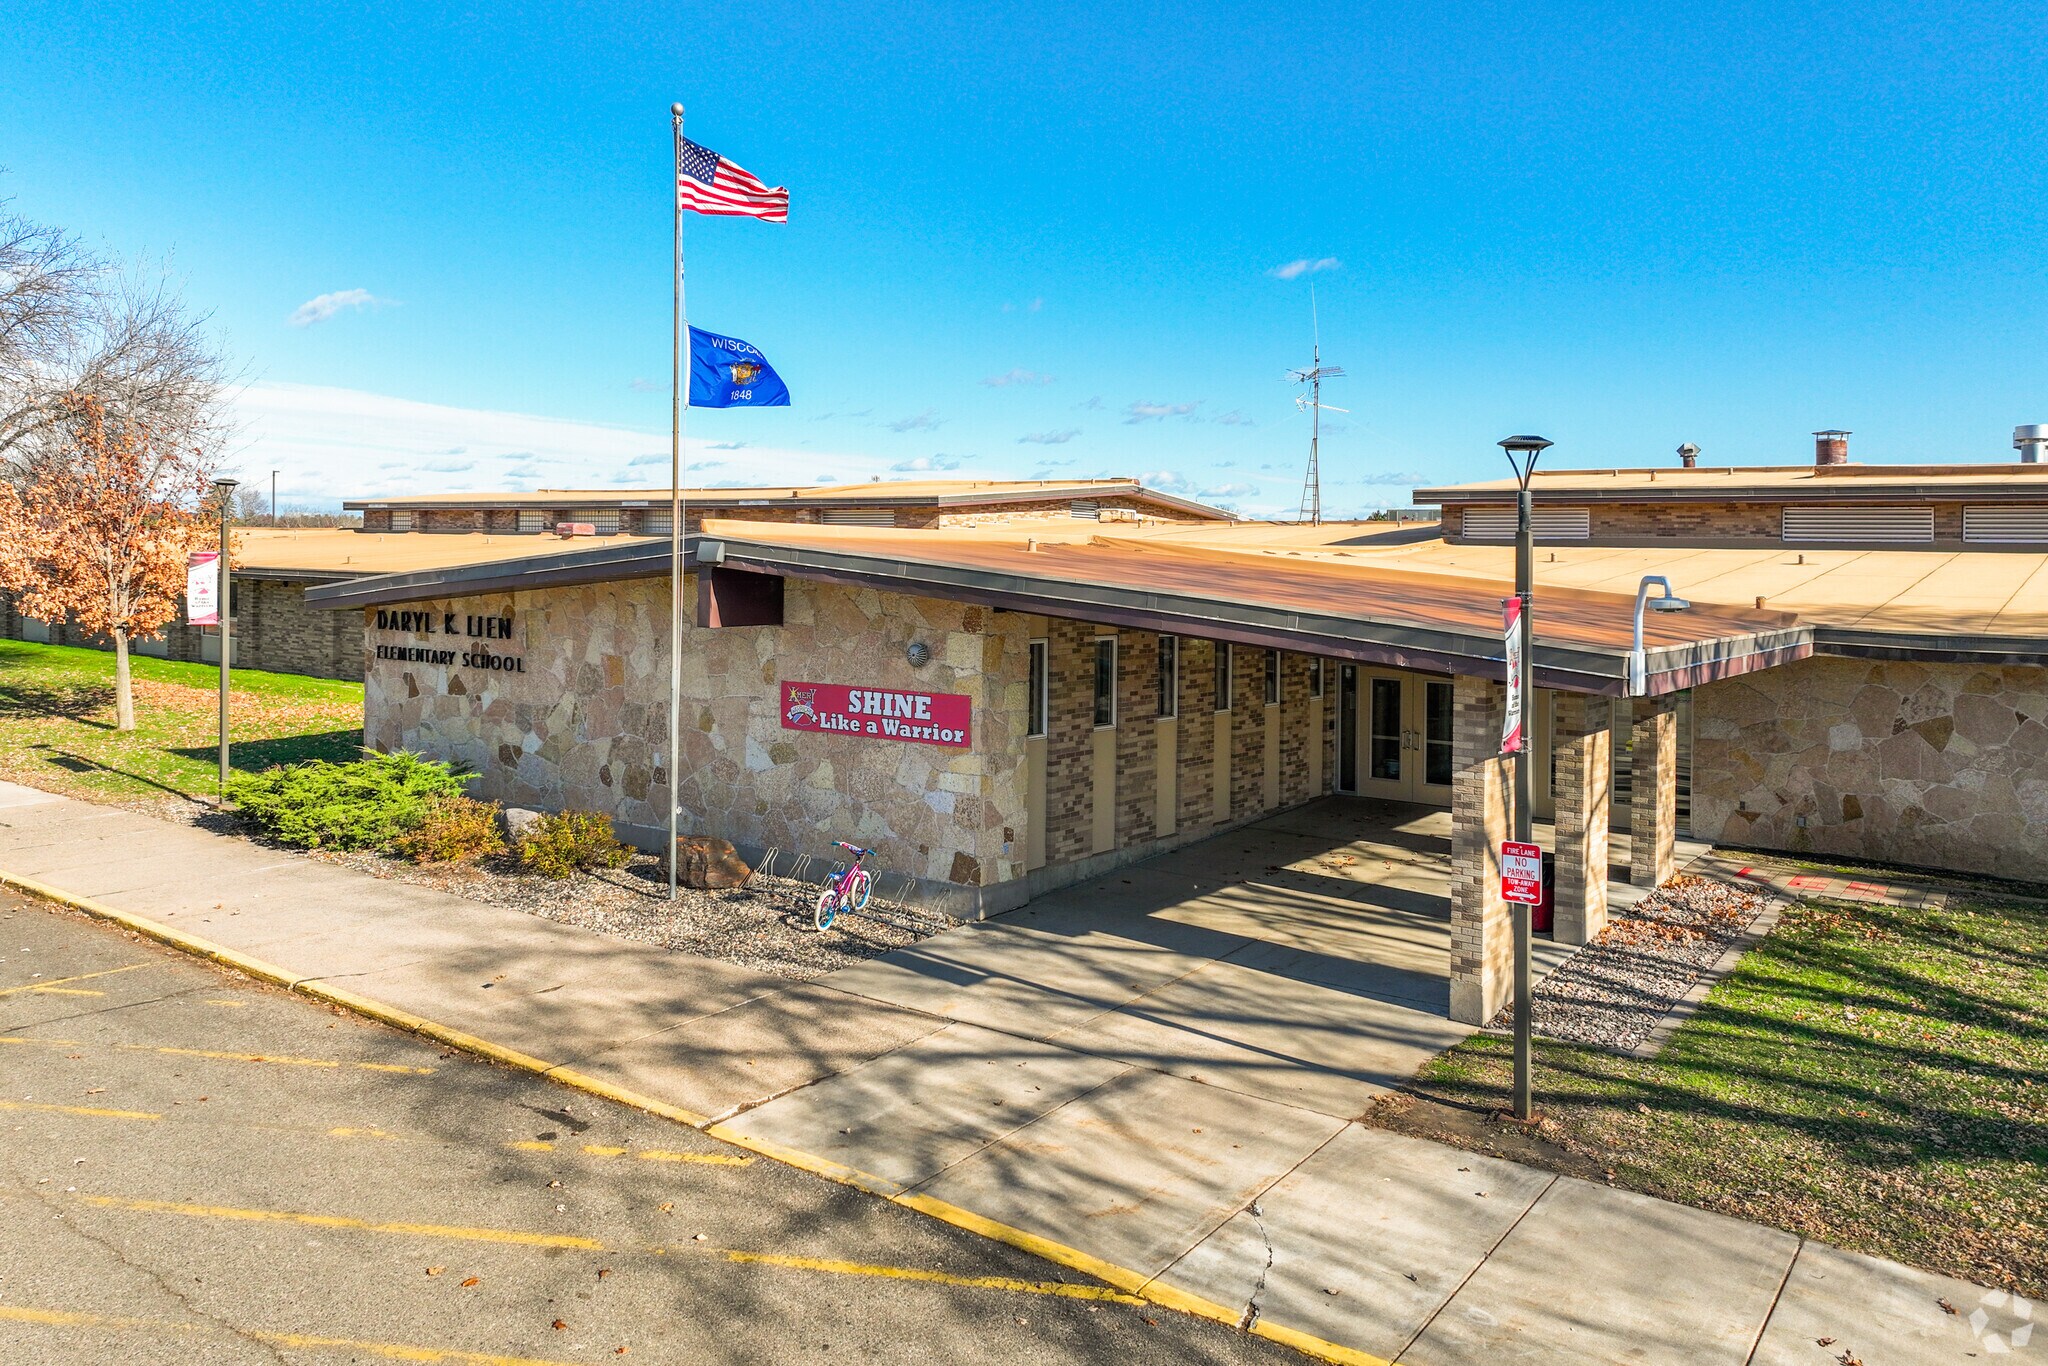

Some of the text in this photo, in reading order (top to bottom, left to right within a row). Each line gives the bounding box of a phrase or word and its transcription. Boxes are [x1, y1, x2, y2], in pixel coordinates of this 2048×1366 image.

[731, 390, 752, 400] 1848
[377, 610, 436, 633] DARYL
[467, 615, 512, 639] LIEN
[377, 645, 526, 673] ELEMENTARY SCHOOL
[848, 689, 932, 721] SHINE
[819, 712, 965, 743] Like a Warrior
[1507, 847, 1535, 857] FIRE LANE
[1515, 857, 1527, 867] NO
[1507, 867, 1535, 879] PARKING
[1507, 878, 1535, 887] TOW-AWAY
[1513, 885, 1528, 893] ZONE
